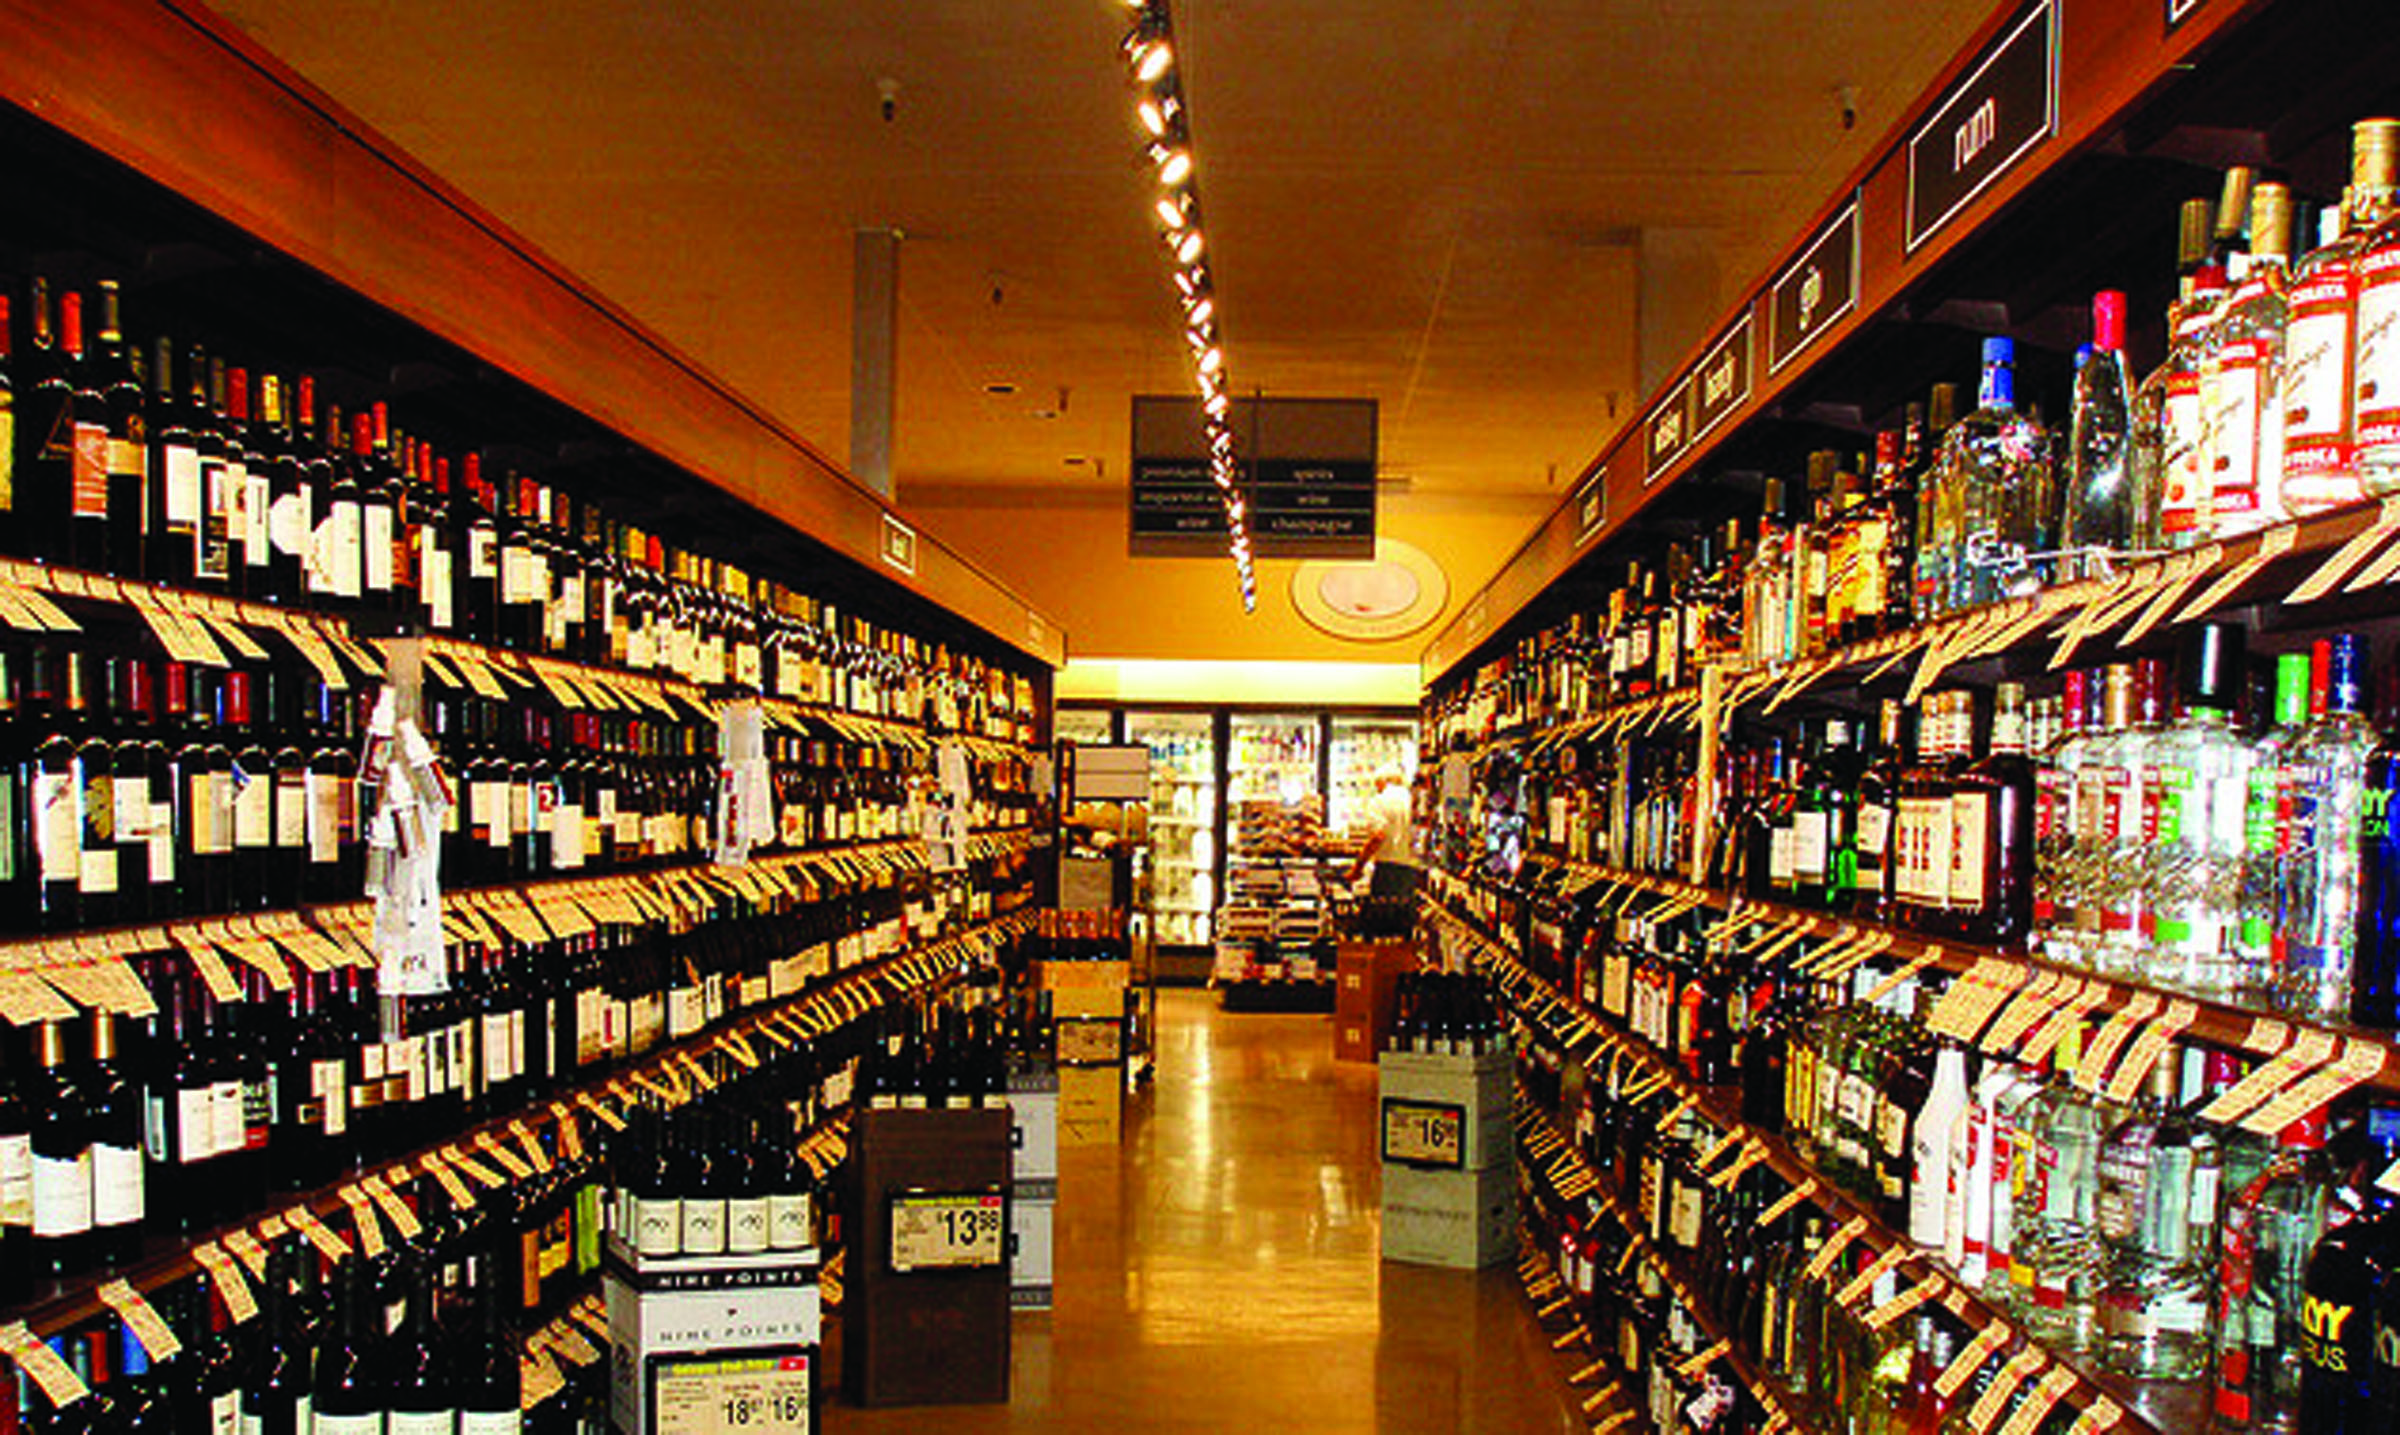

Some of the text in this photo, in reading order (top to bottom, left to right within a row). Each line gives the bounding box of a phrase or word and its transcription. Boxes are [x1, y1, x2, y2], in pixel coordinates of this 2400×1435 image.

[1953, 97, 1994, 172] rum
[1298, 492, 1330, 505] wine
[1176, 516, 1210, 528] wine
[1271, 516, 1353, 534] champagne
[657, 1271, 802, 1288] NINE POINTS
[659, 1323, 803, 1342] NINE POINTS
